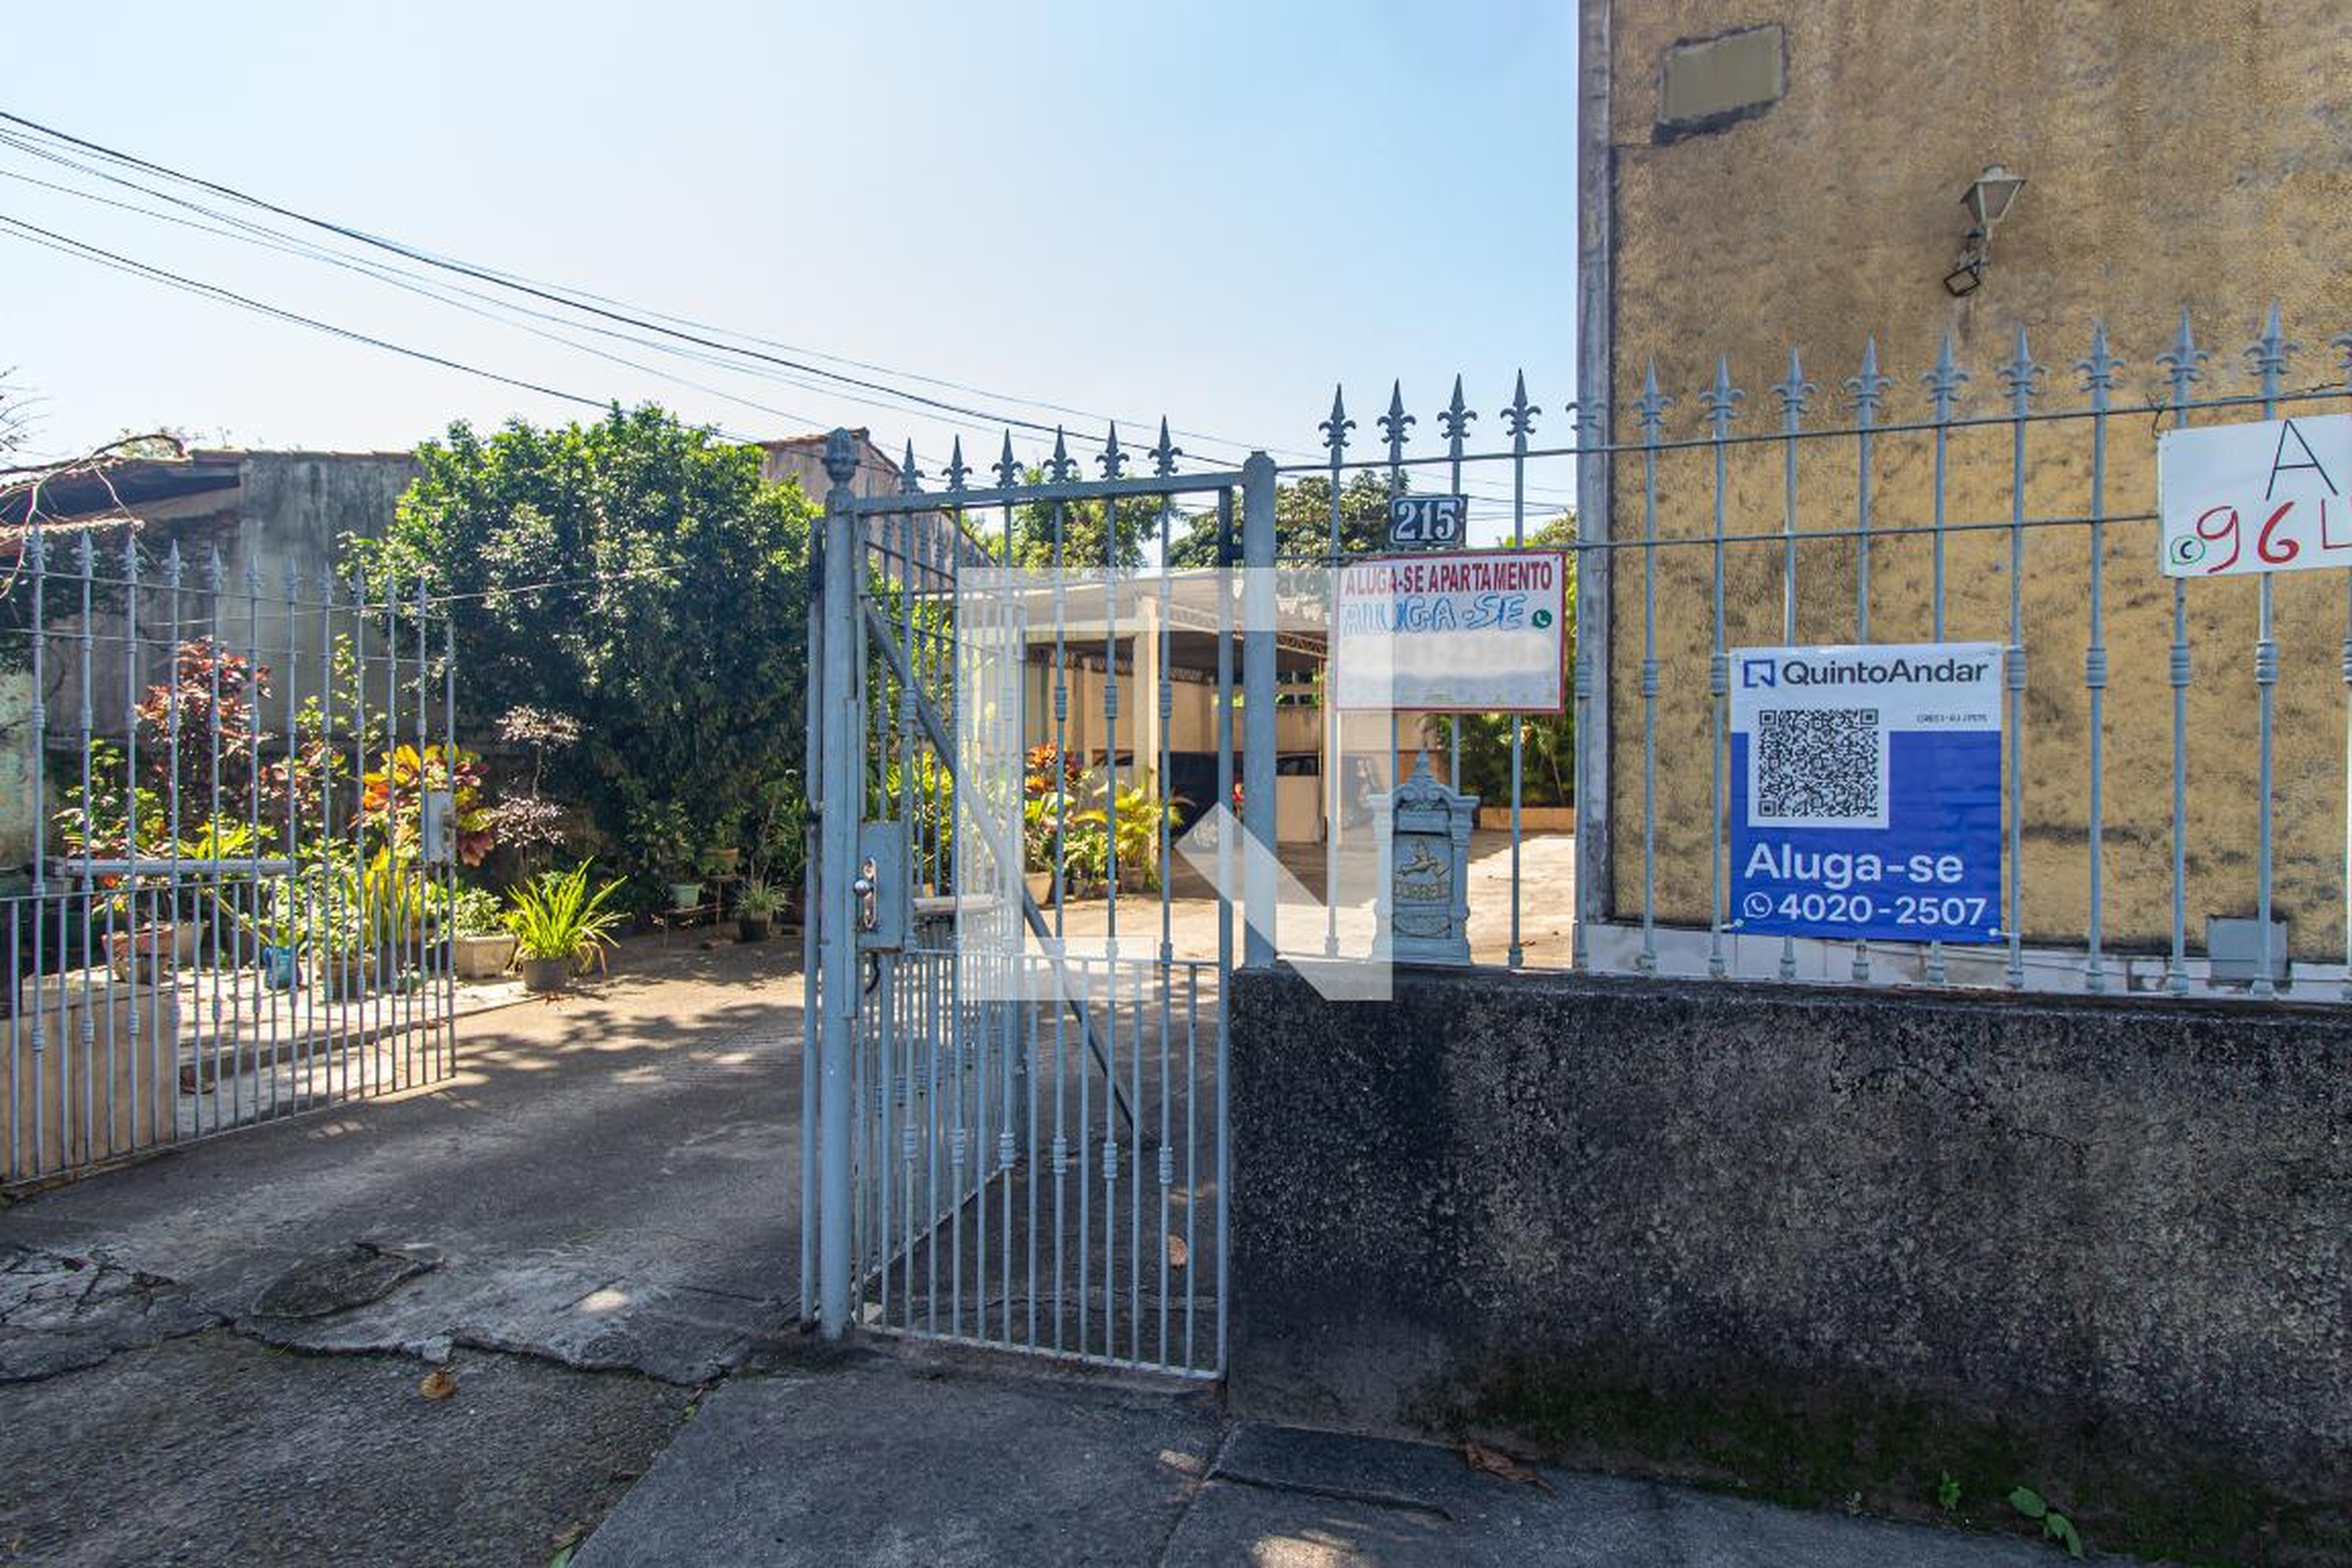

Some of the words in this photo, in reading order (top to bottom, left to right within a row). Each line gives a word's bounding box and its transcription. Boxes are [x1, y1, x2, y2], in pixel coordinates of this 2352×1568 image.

[1396, 501, 1455, 540] 215
[1345, 565, 1424, 595] ALUGA-SE
[1428, 560, 1552, 593] APARTAMENTO
[1782, 658, 1989, 686] QuintoAndar
[1744, 842, 1964, 890] Aluga-se
[1777, 893, 1988, 926] 4020-2507
